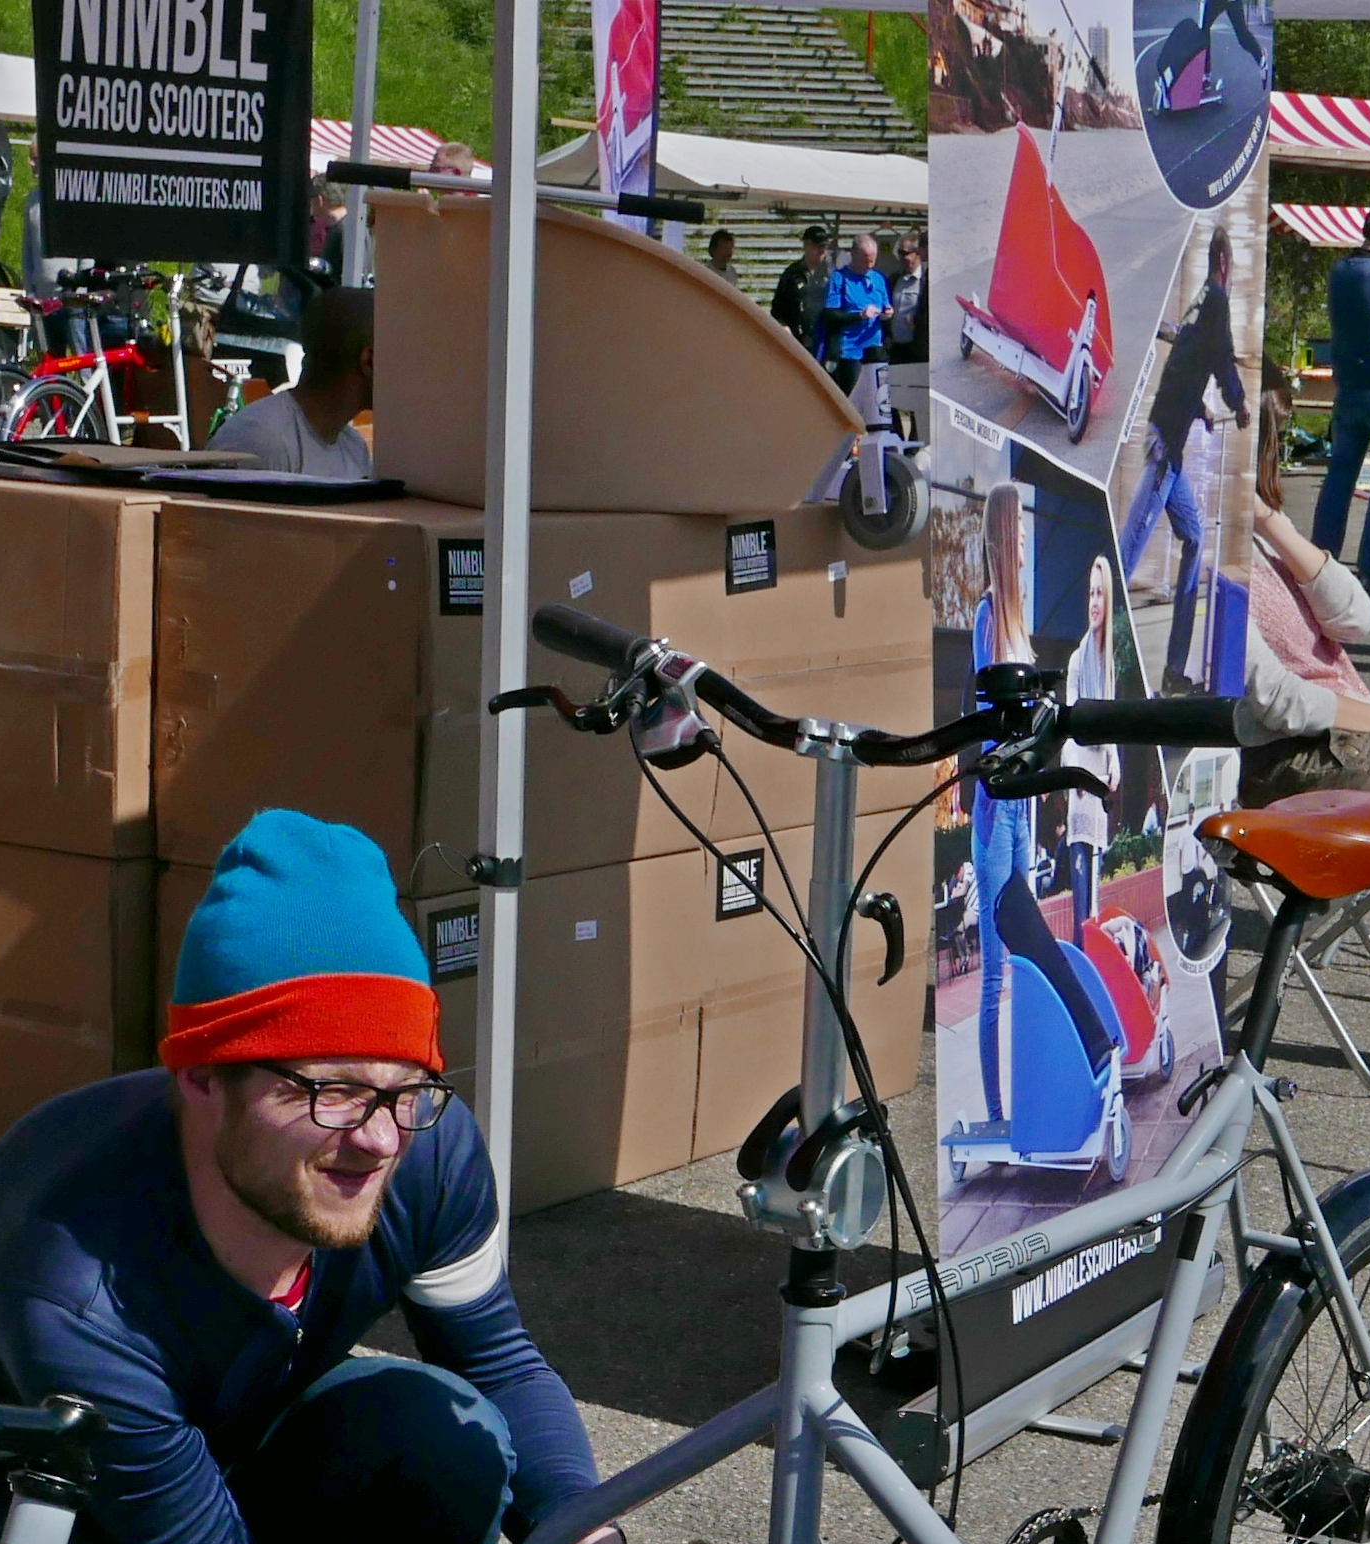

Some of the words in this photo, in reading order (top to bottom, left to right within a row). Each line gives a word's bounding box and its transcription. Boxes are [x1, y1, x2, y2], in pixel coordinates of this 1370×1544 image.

[60, 0, 267, 81] NIMBLE
[56, 73, 142, 132] CARGO
[148, 82, 265, 143] SCOOTERS
[55, 168, 262, 211] WWW.NIMBLESCOOTERS.COM
[449, 550, 484, 576] NIMBL
[732, 530, 768, 559] NIMBLE
[437, 914, 478, 946] NIMBLE
[906, 1231, 1051, 1309] PATRIA
